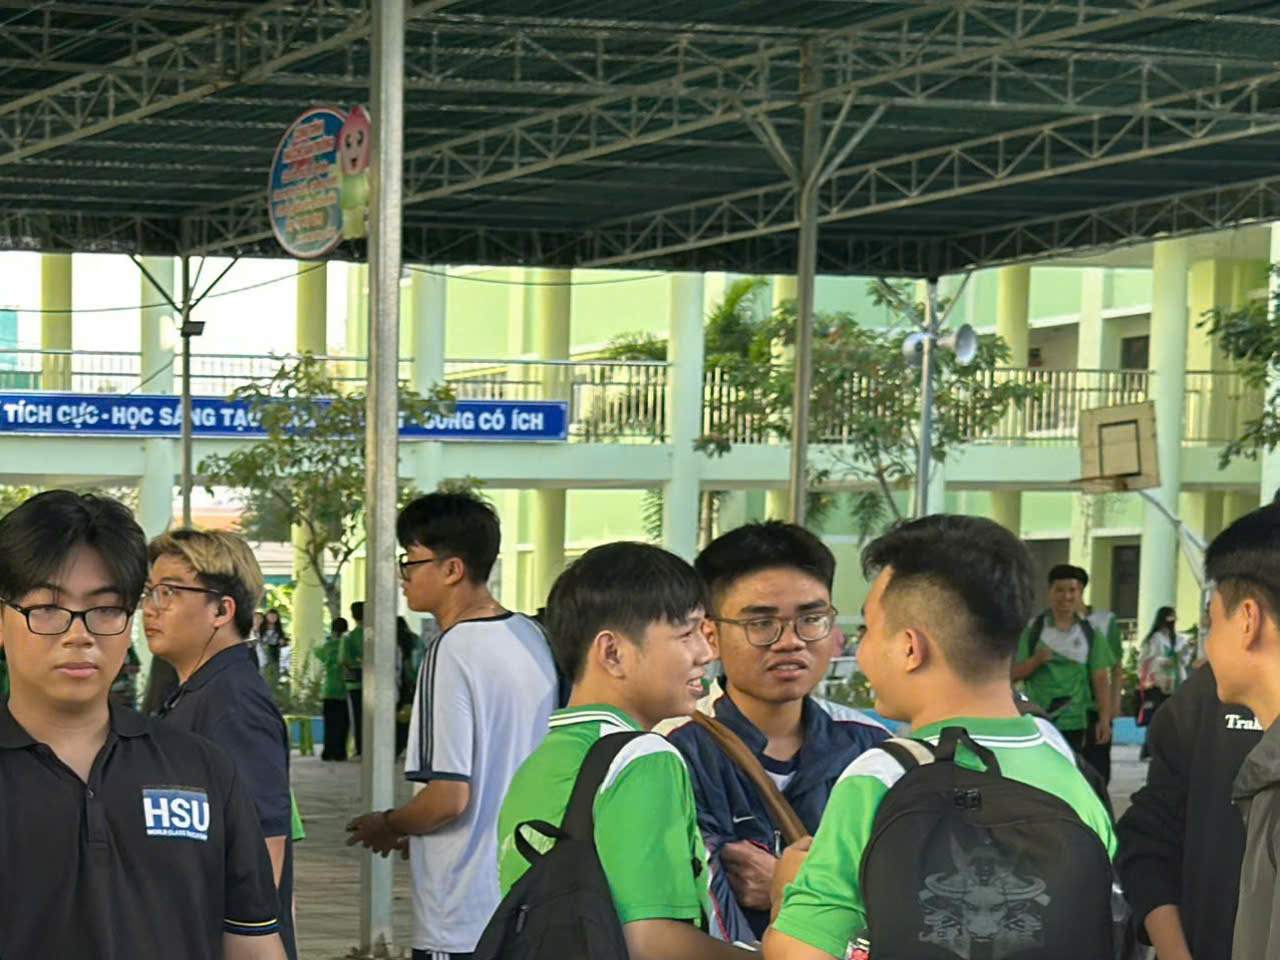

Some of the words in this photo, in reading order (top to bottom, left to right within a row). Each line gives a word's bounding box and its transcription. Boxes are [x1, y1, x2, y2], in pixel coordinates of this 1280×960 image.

[4, 400, 53, 424] TÍCH
[56, 402, 99, 429] CỰC
[111, 406, 154, 430] HỌC
[478, 408, 506, 430] CÓ
[511, 407, 544, 430] ÍCH
[143, 797, 210, 832] HSU
